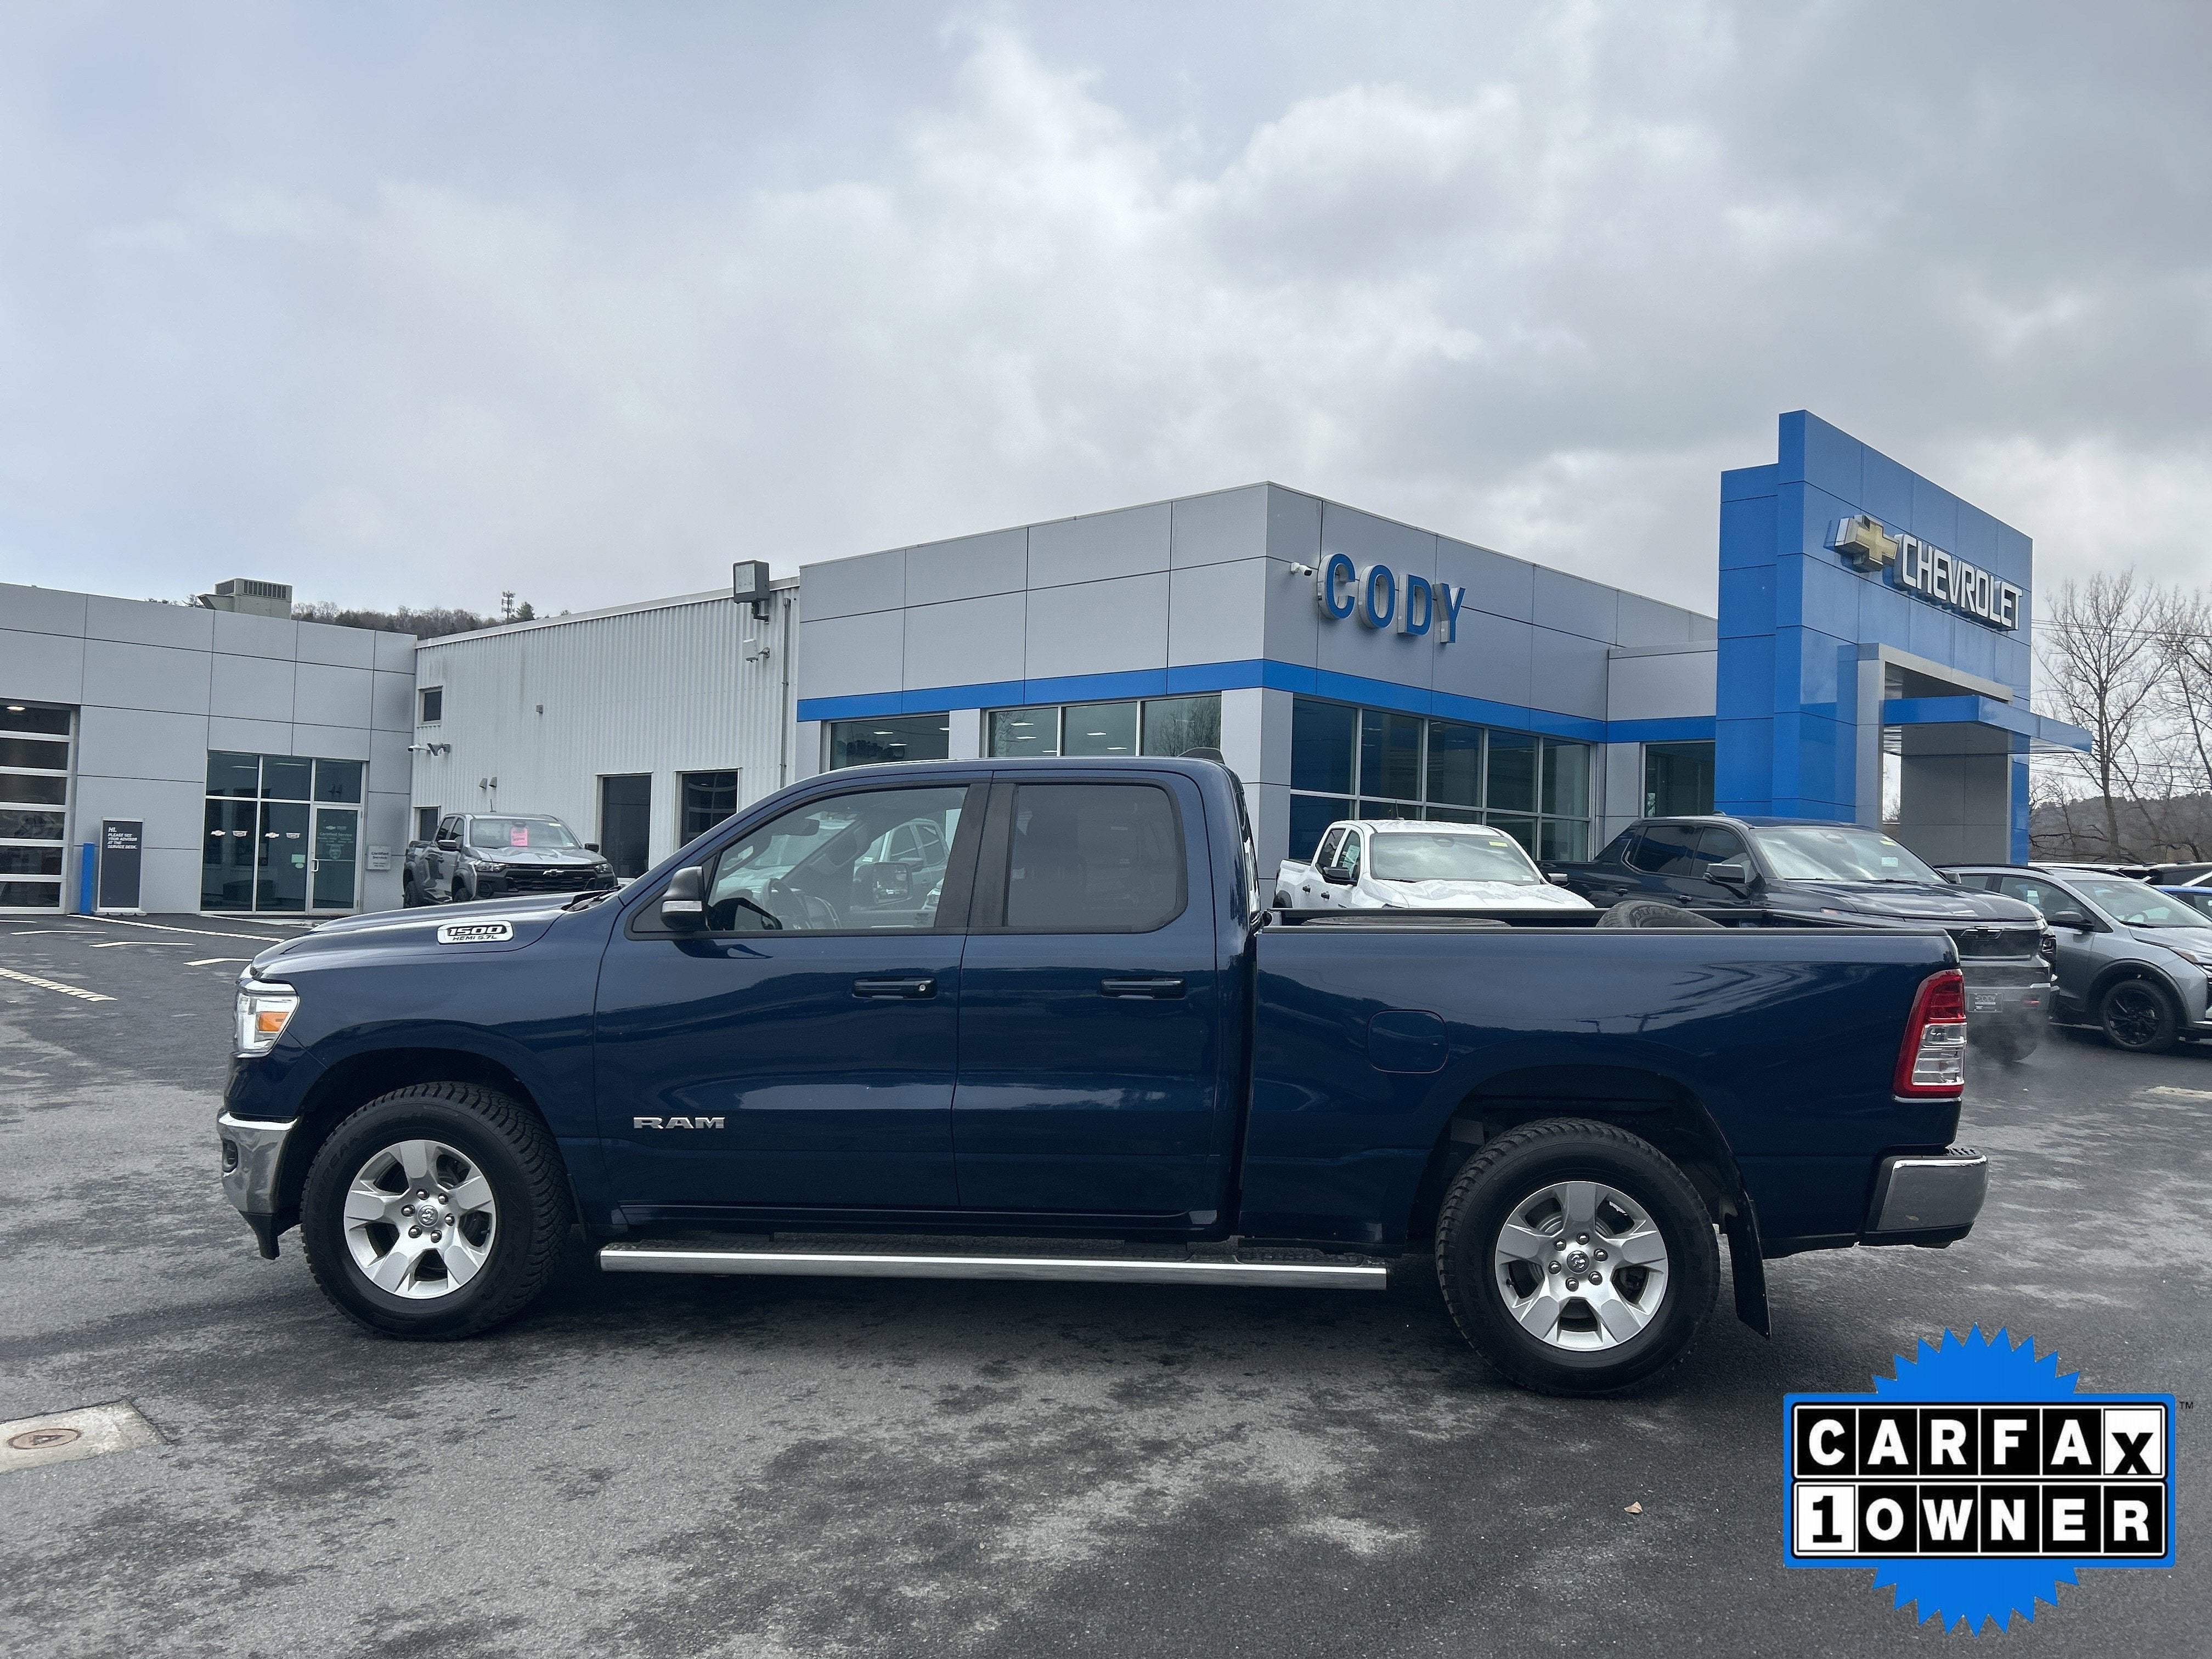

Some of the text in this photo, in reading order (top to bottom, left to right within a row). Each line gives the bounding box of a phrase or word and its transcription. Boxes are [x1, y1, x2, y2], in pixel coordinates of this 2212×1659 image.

[1317, 553, 1466, 643] CODY
[1897, 534, 2023, 630] CHEVROLET
[450, 926, 503, 935] 1500
[634, 1117, 725, 1129] RAM
